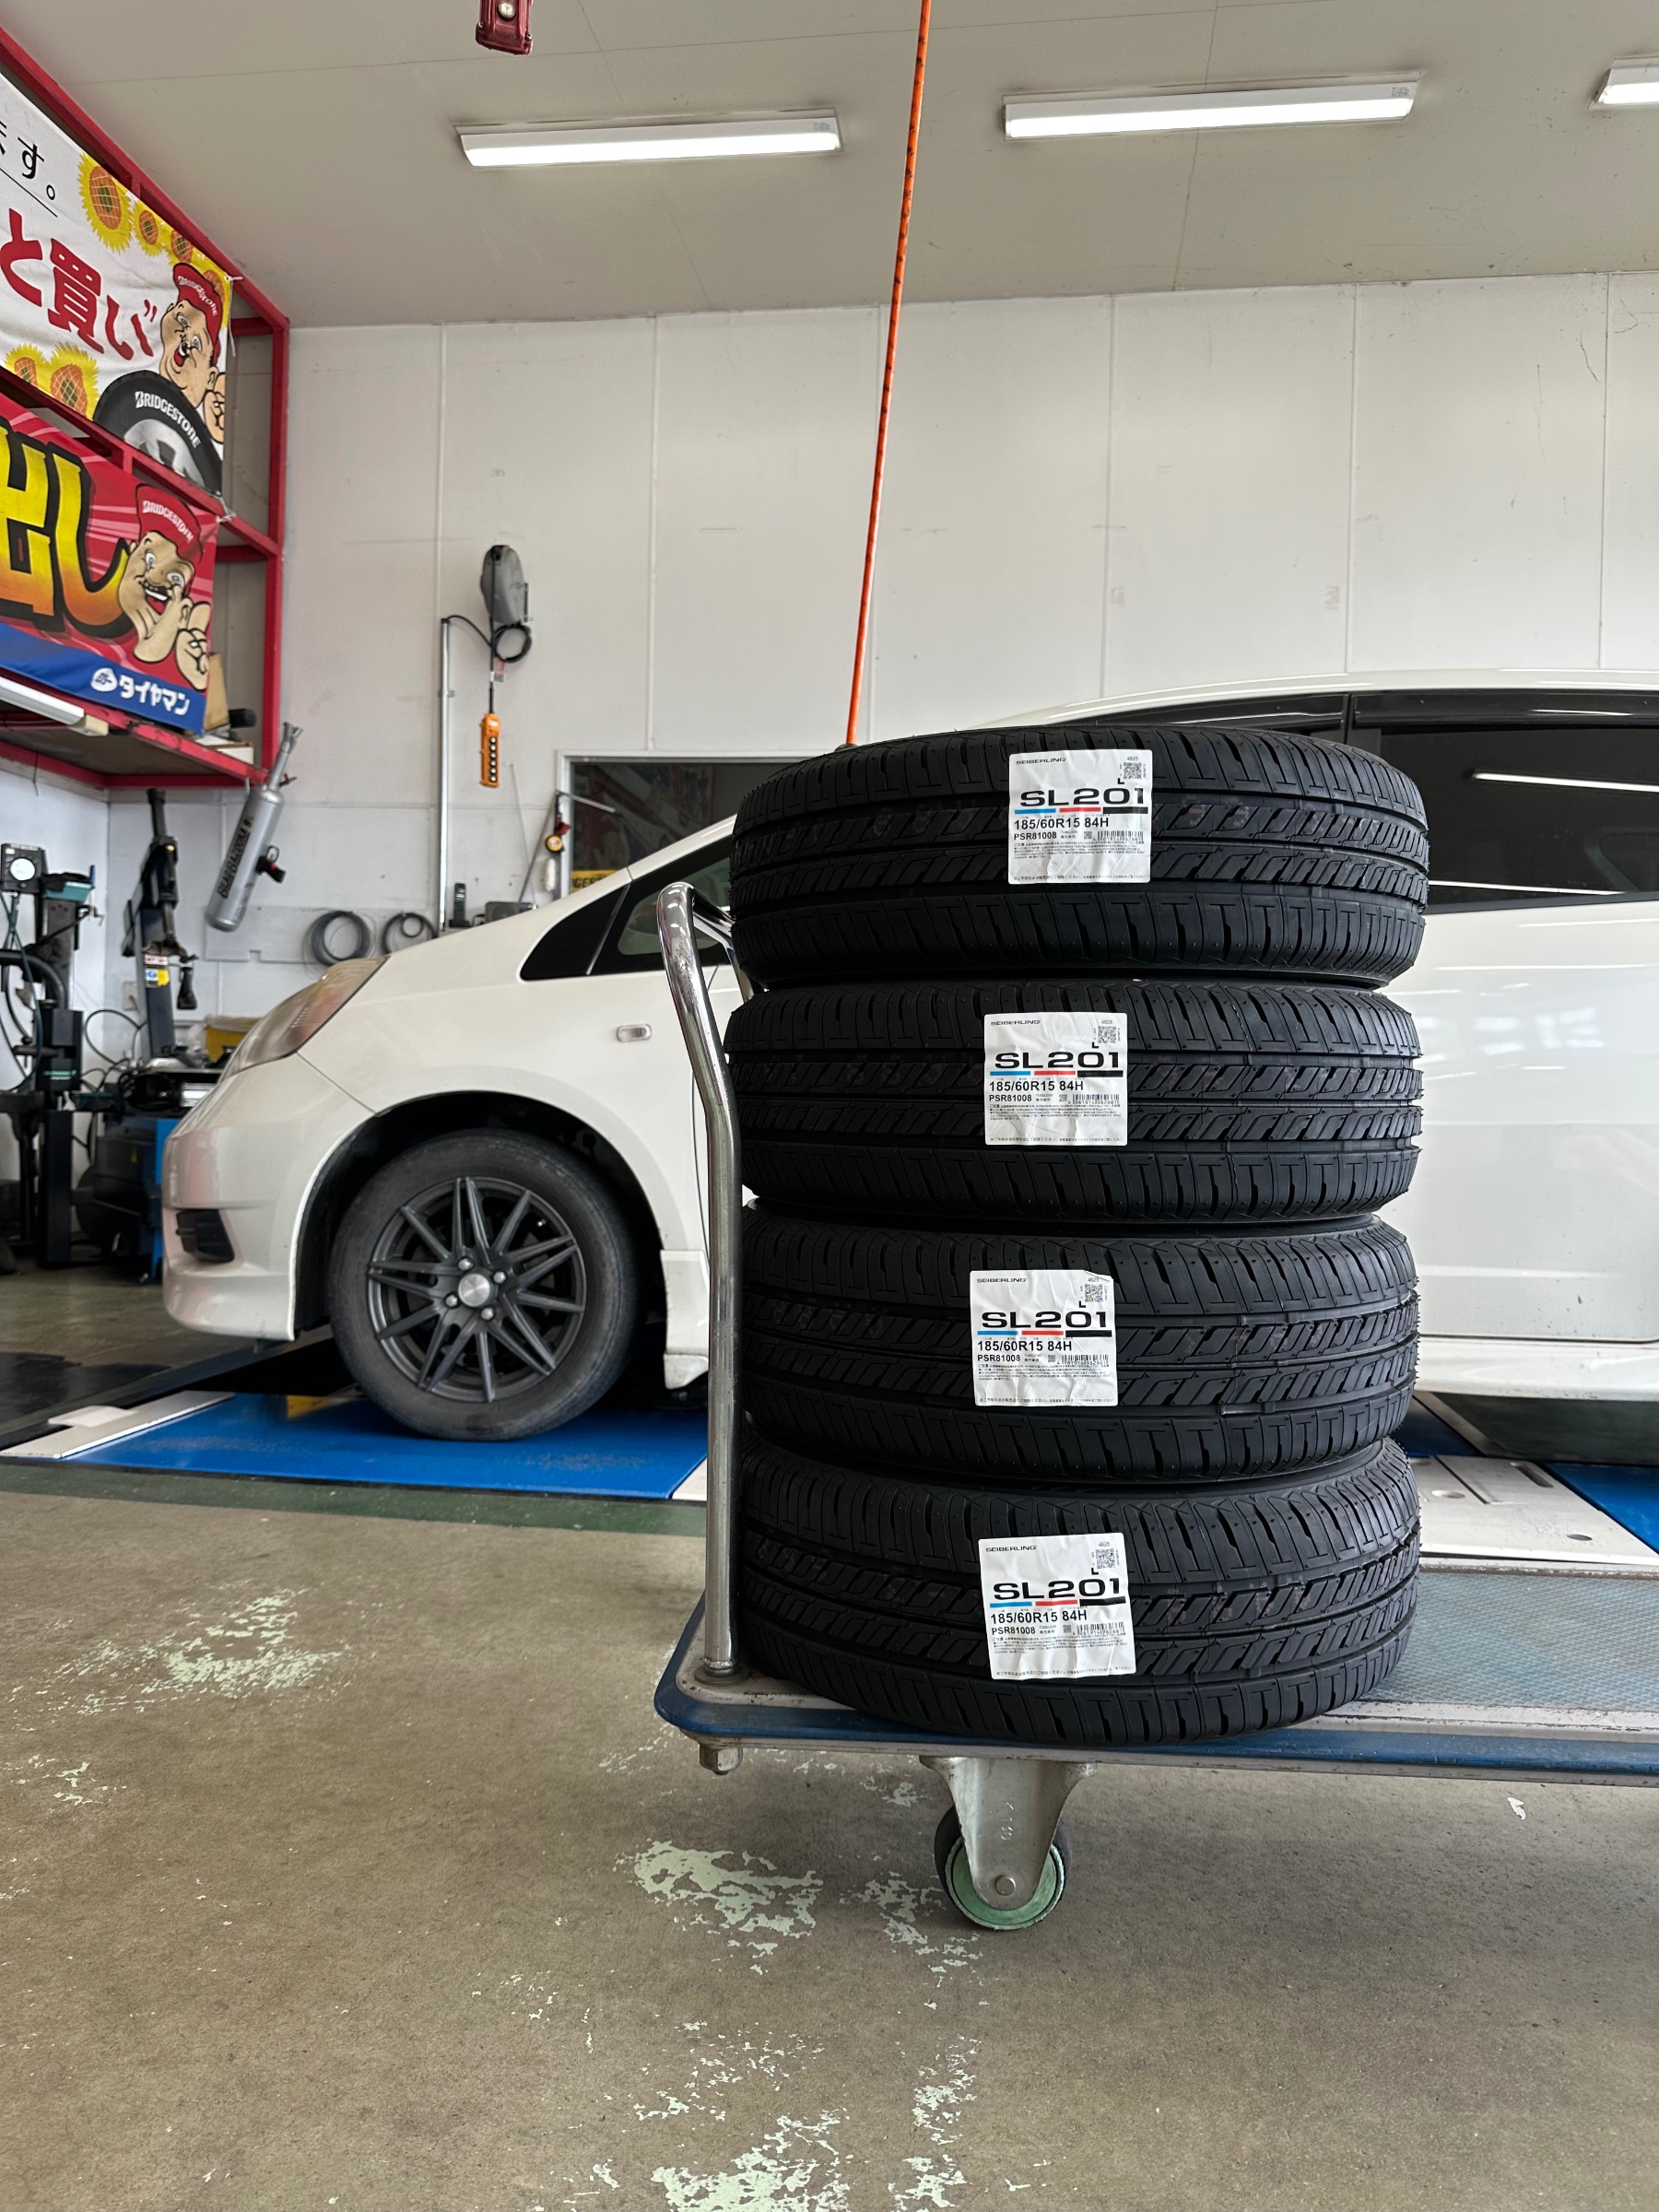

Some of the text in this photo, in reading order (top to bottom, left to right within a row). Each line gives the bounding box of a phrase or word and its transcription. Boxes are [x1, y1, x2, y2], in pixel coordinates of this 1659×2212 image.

[178, 276, 218, 316] BRIDGESTONE
[135, 391, 201, 448] BRIDGESTONE
[118, 675, 190, 715] タイヤマン
[1020, 788, 1143, 806] SL201
[1014, 818, 1109, 830] 185/60R15 84H
[995, 1052, 1118, 1068] SL201
[990, 1081, 1083, 1091] 185/60R15 84H
[982, 1312, 1105, 1327] SL201
[978, 1341, 1072, 1351] 185/60R15 84H
[994, 1578, 1120, 1599] SL201
[991, 1610, 1087, 1624] 185/60R15 84H
[992, 1627, 1035, 1635] PSR81008
